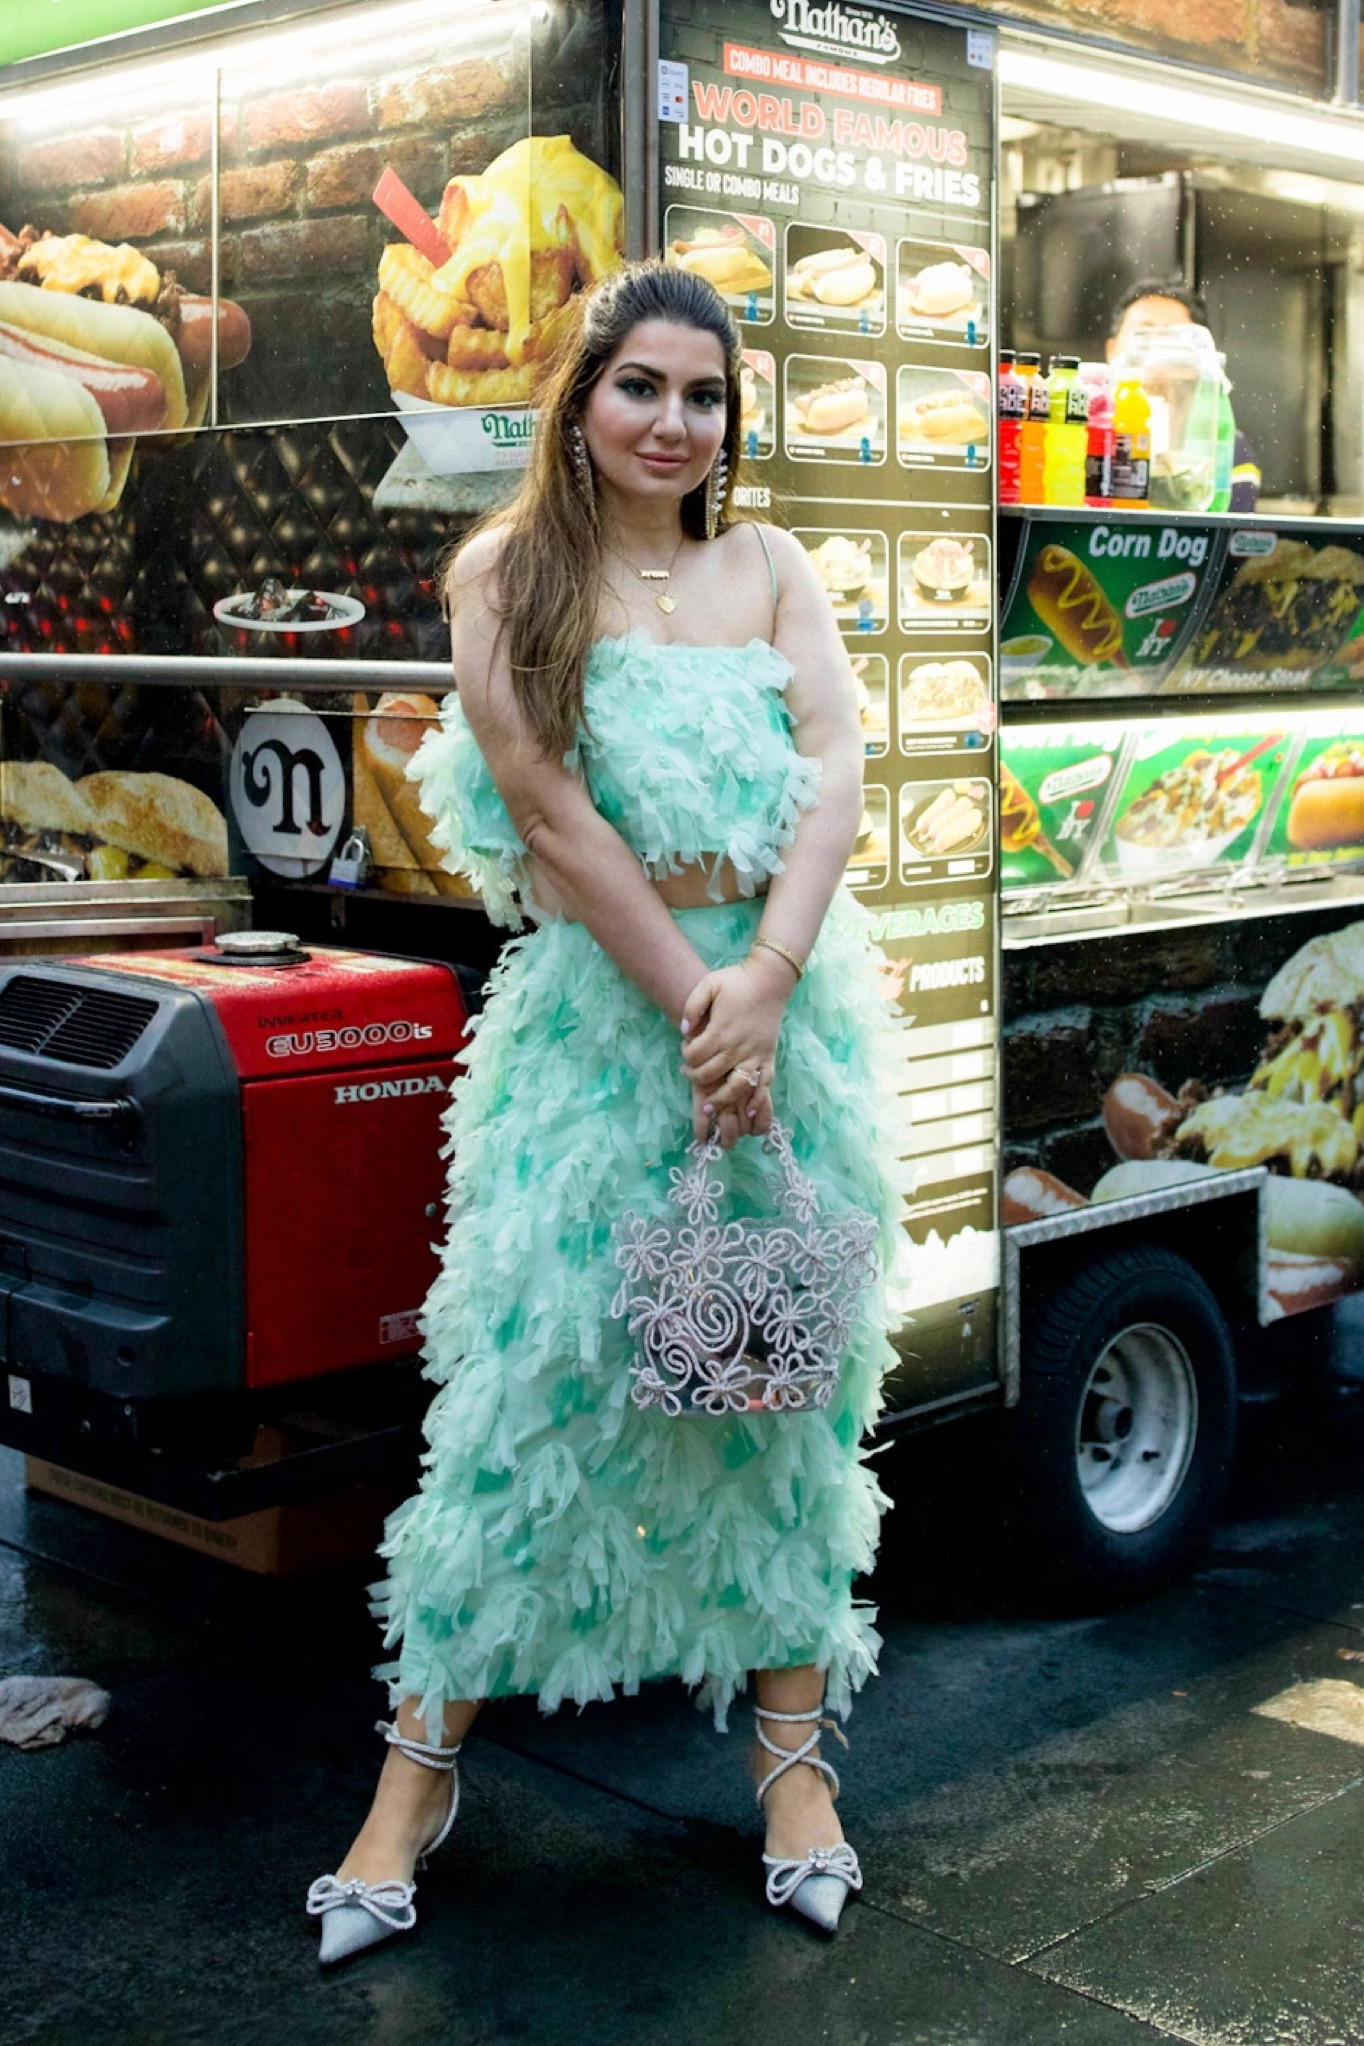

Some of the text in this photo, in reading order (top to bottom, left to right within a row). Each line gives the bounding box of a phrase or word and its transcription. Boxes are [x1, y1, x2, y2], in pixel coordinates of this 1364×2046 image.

[770, 0, 897, 52] Nathan's
[730, 49, 936, 110] COMBO MEAL INCLUDES REGULAR FRIES
[692, 82, 825, 138] WORLD
[834, 109, 967, 166] FAMOUS
[665, 165, 799, 206] SINGLE OR COMBO MEALS
[679, 124, 980, 207] HOT DOGS & FRIES
[733, 486, 770, 508] ORITES
[1088, 525, 1152, 557] Corn
[1157, 527, 1208, 567] Dog
[870, 901, 985, 941] VERAGES
[909, 955, 985, 993] PRODUCTS
[334, 1075, 446, 1105] HONDA
